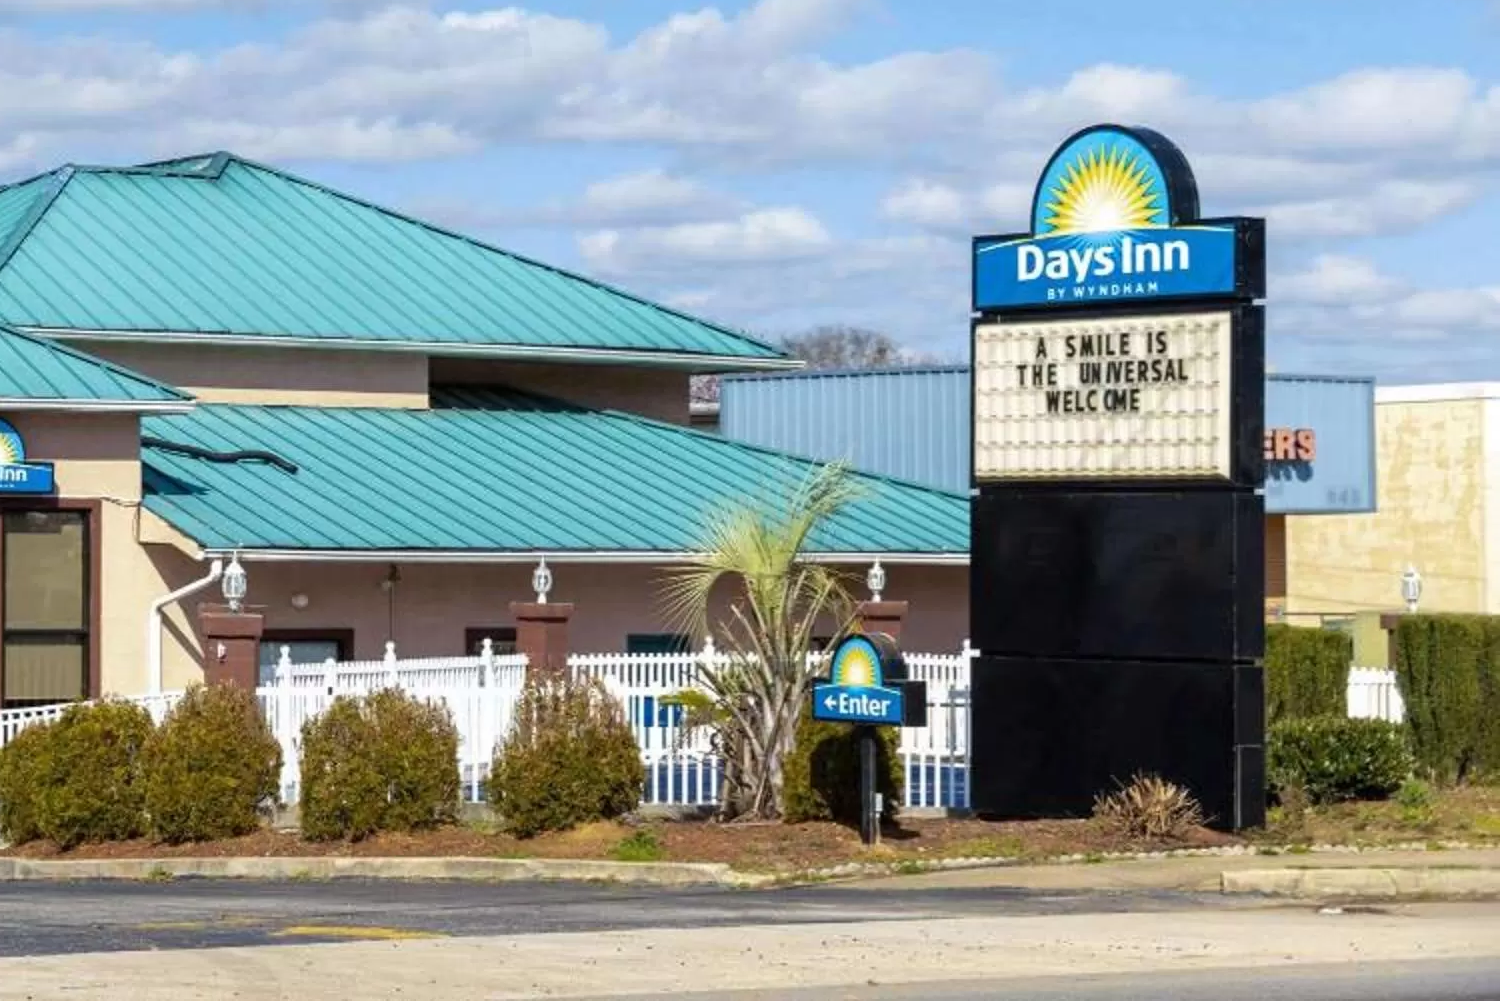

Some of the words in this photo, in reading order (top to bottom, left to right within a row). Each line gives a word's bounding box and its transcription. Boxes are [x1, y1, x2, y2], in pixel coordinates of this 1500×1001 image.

[1017, 243, 1115, 284] Days
[1122, 236, 1190, 275] Inn
[1046, 287, 1066, 301] BY
[1073, 281, 1159, 299] WYNDHAM
[1035, 336, 1048, 359] A
[1065, 332, 1131, 358] SMILE
[1147, 330, 1168, 354] IS
[1016, 363, 1057, 386] THE
[1079, 358, 1189, 385] UNIVERSAL
[1045, 388, 1141, 412] WELCOME
[838, 693, 892, 717] Enter
